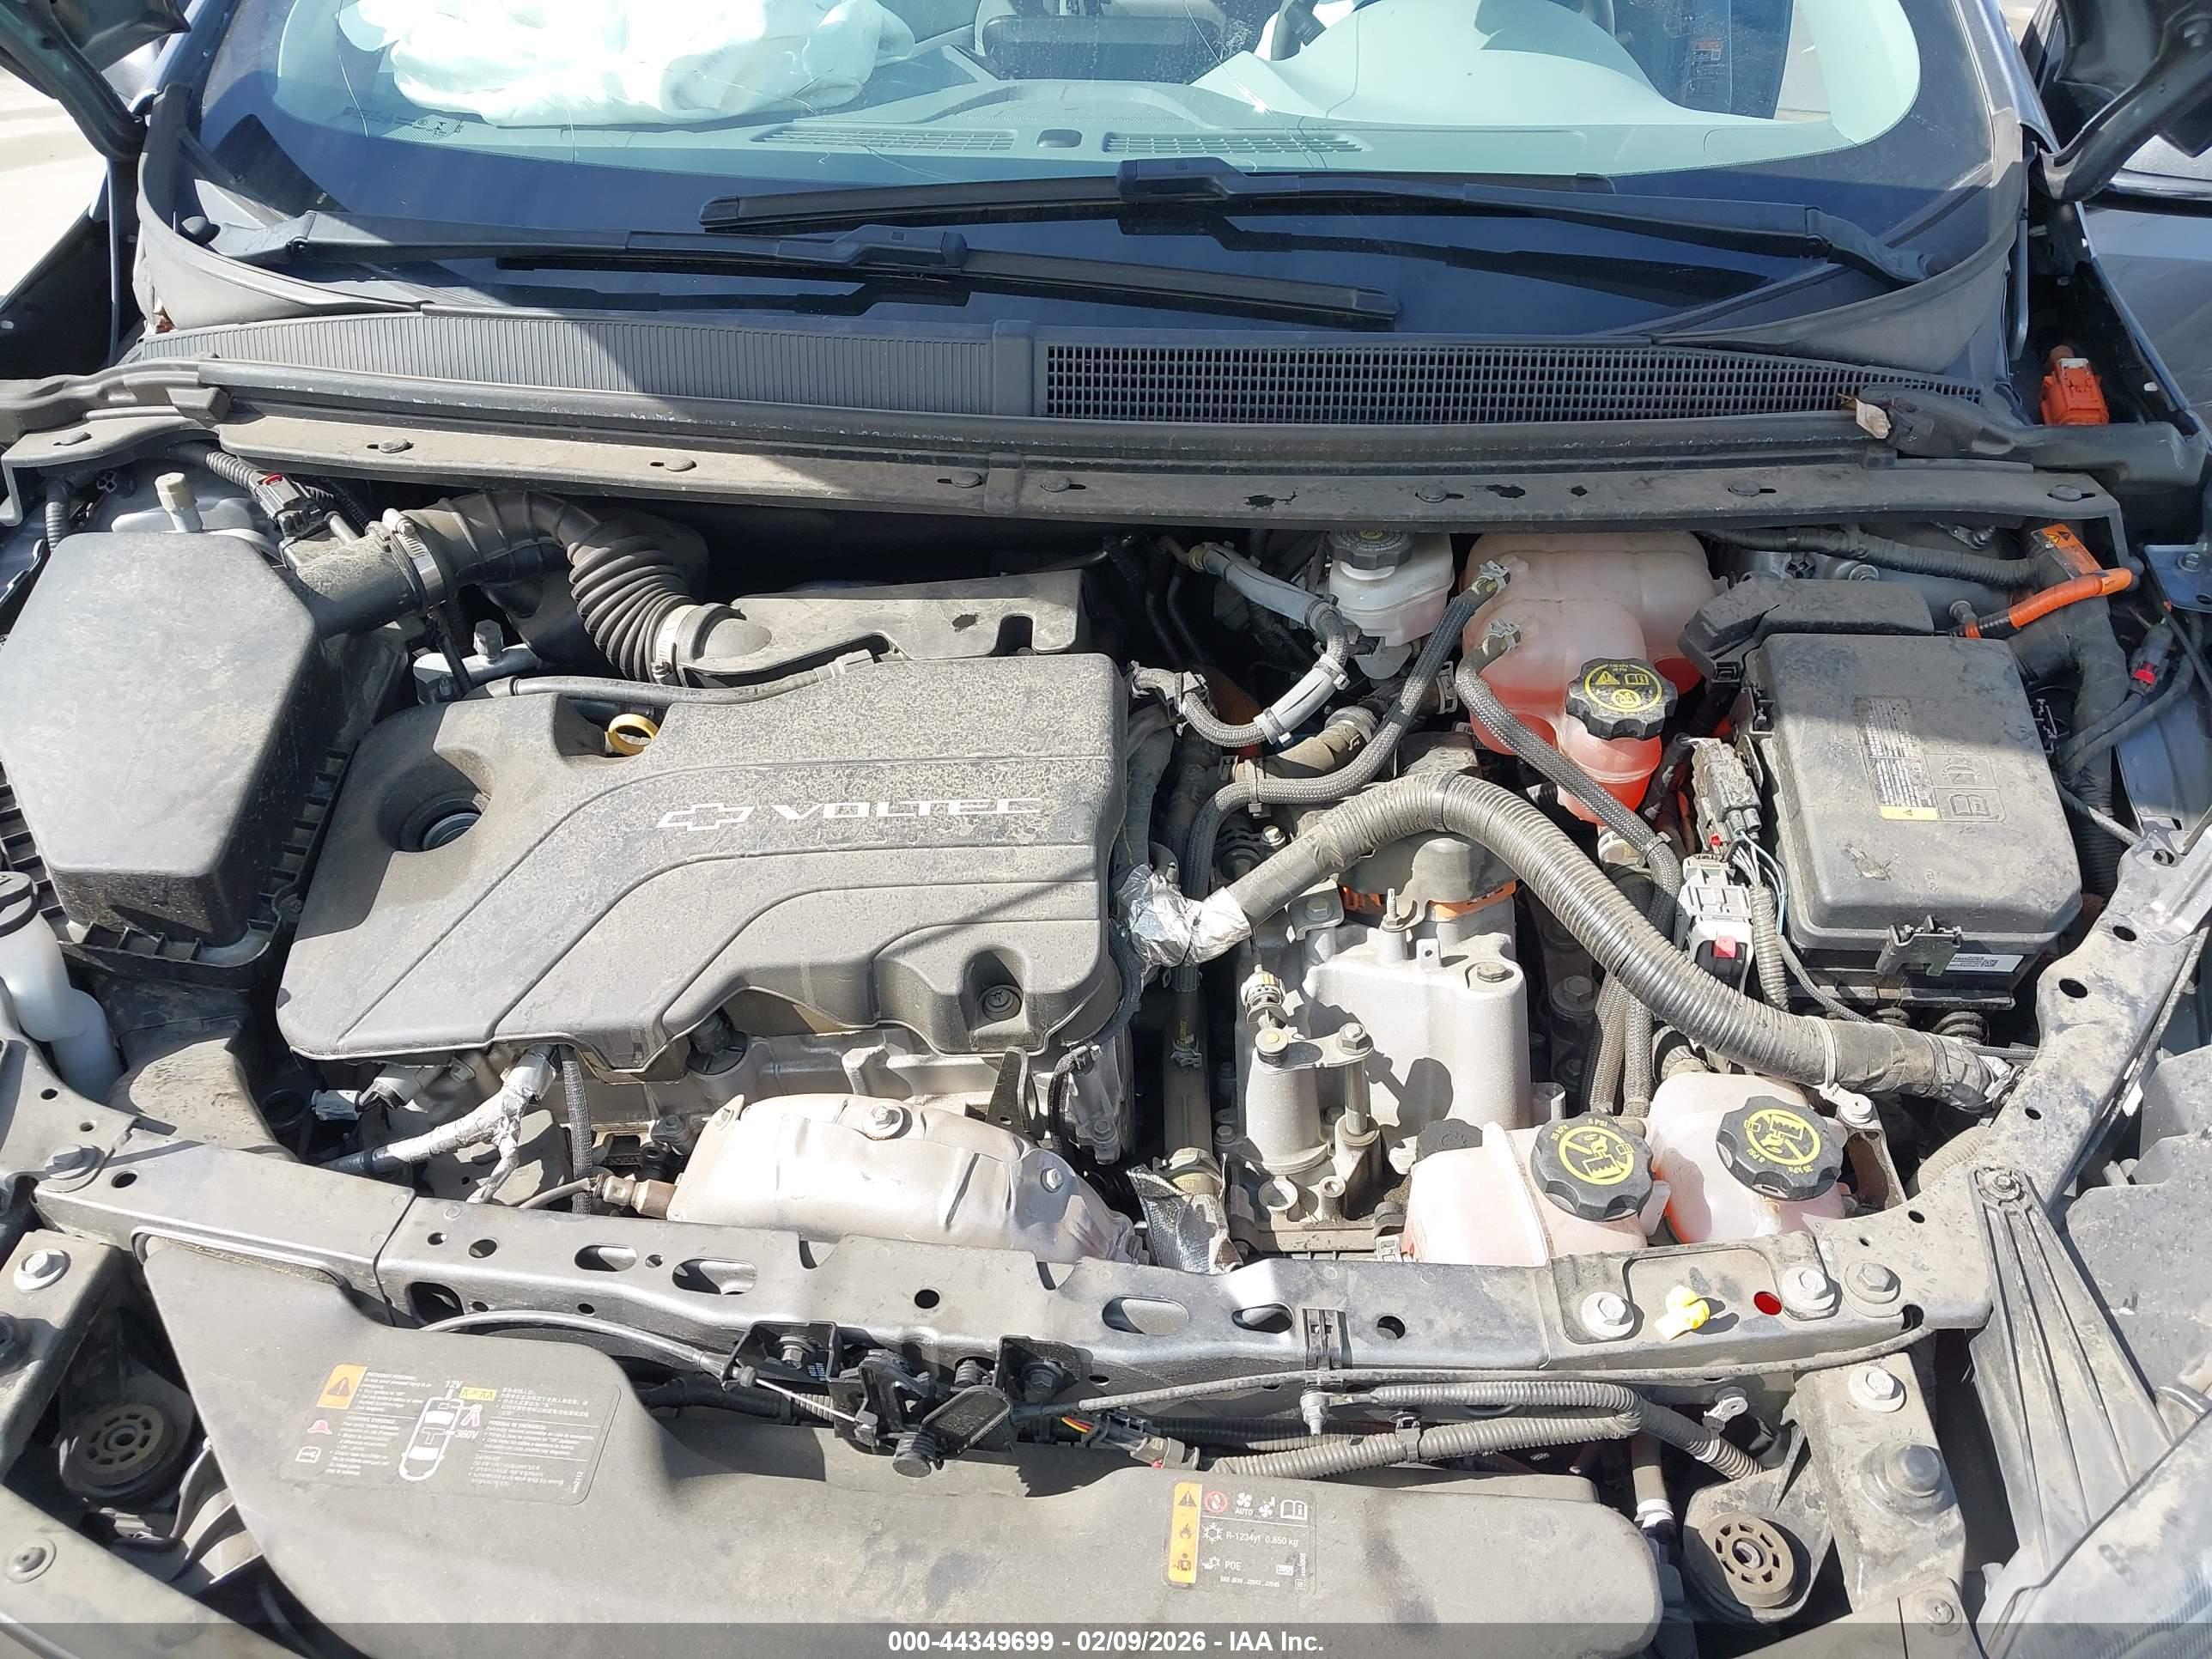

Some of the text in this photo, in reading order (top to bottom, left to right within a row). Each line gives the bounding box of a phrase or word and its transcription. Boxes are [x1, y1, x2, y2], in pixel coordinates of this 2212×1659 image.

[772, 798, 1041, 821] VOLTEC
[1595, 1119, 1608, 1127] PSI
[1551, 1124, 1569, 1140] 35 kPa
[1747, 1148, 1760, 1159] PSI
[1788, 1165, 1803, 1174] kPa
[445, 1379, 462, 1389] 12V
[455, 1430, 479, 1439] 360V
[1226, 1532, 1298, 1547] R-1234yf 0.850 kg
[1224, 1561, 1242, 1571] POE
